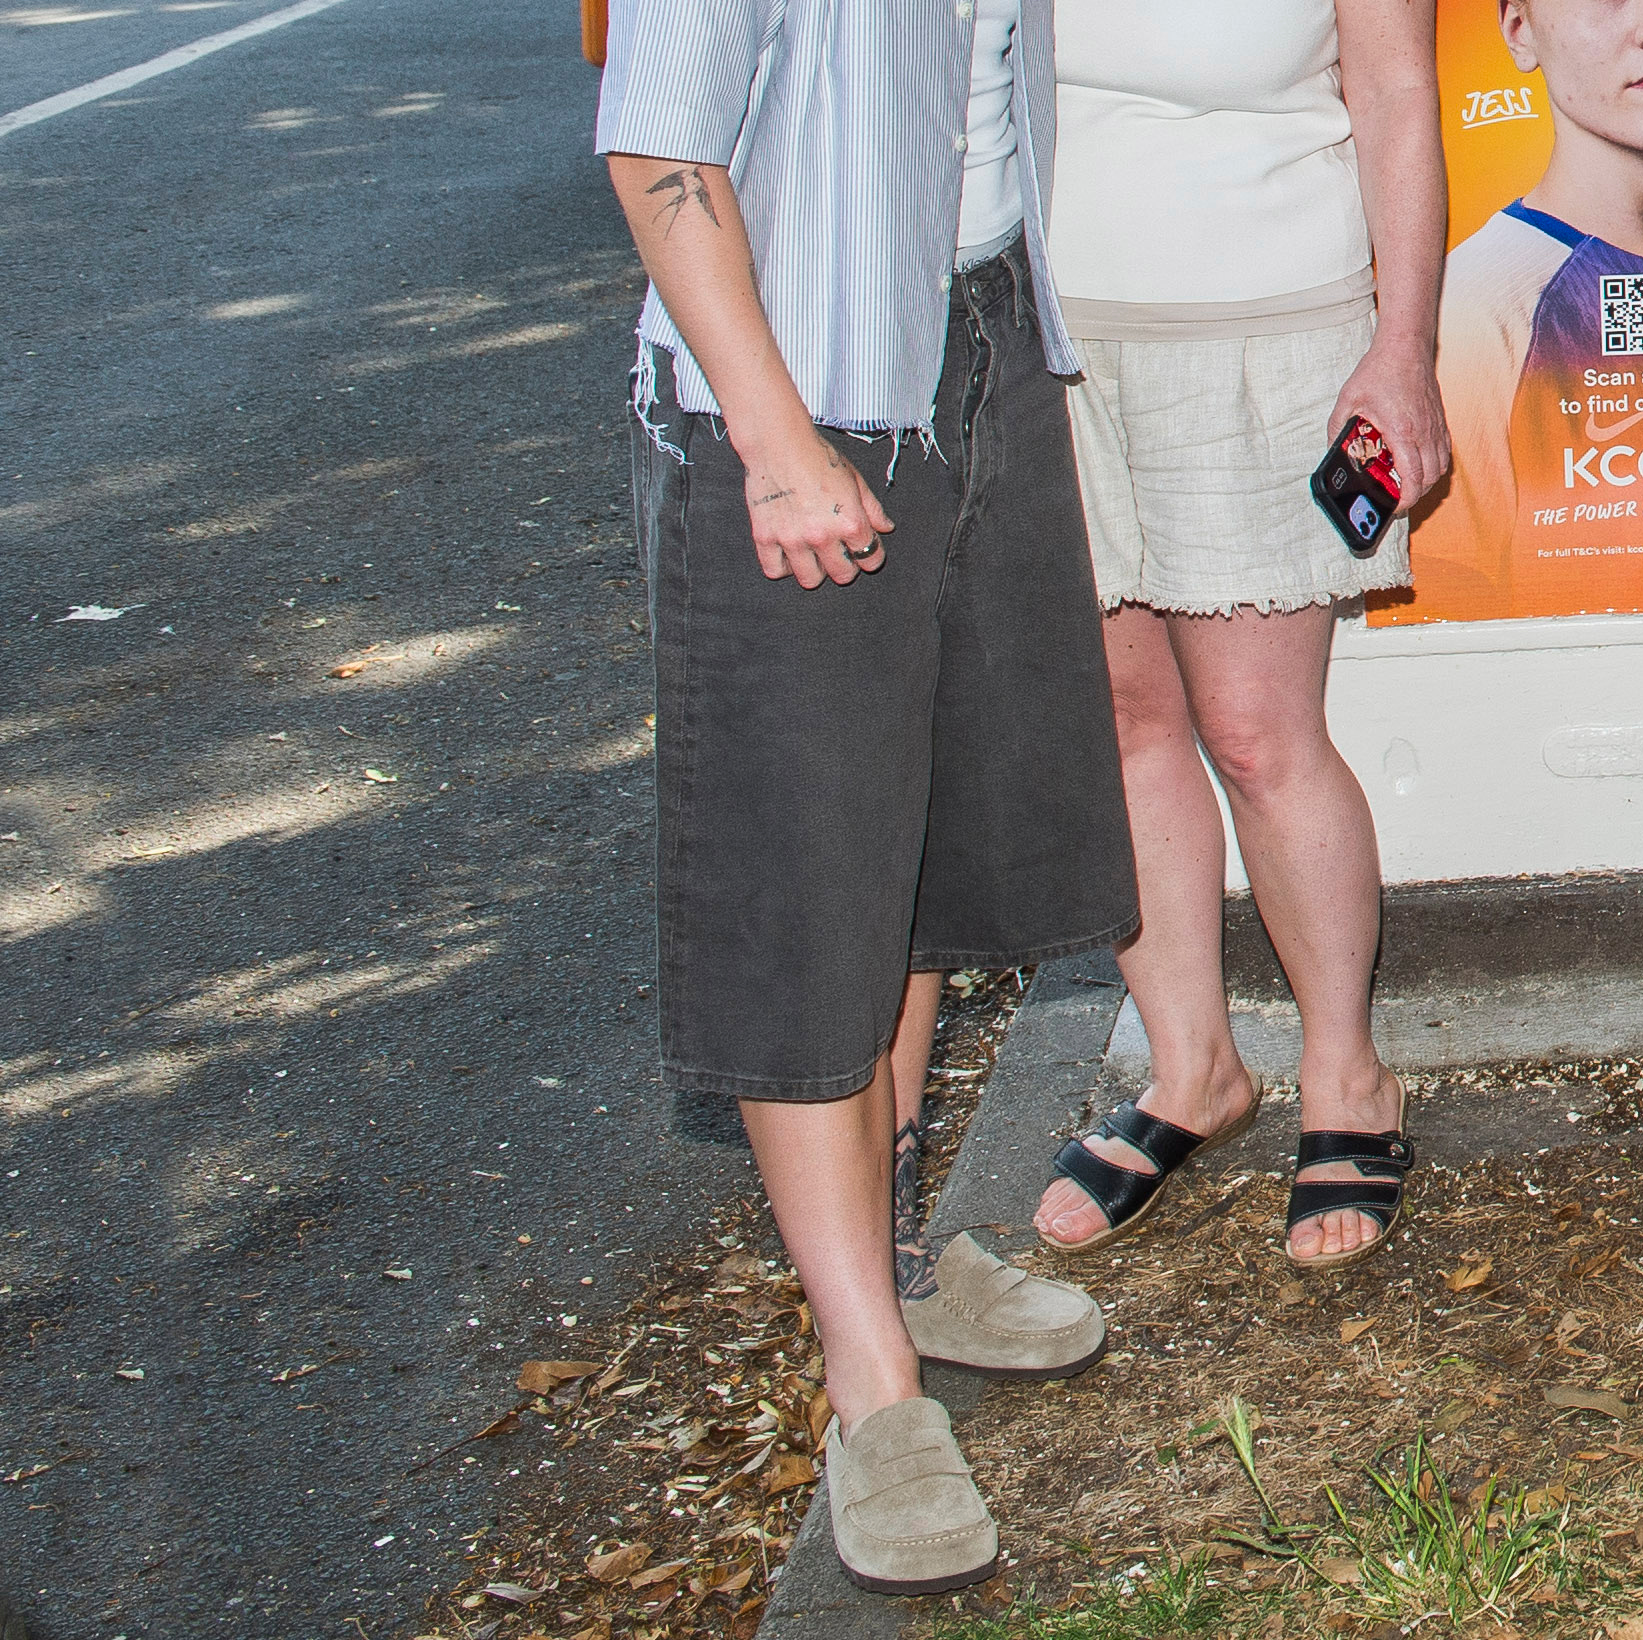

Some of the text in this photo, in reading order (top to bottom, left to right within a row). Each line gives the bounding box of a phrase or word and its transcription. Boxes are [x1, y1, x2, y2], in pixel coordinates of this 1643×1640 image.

[1461, 87, 1533, 123] JESS
[1583, 368, 1635, 387] Scan
[1559, 398, 1582, 414] to
[1587, 394, 1628, 413] find
[1533, 507, 1569, 526] THE
[1573, 499, 1638, 523] POWER
[1537, 549, 1553, 558] For
[1555, 547, 1571, 558] full
[1572, 546, 1600, 557] T&C's
[1602, 545, 1625, 555] visit:
